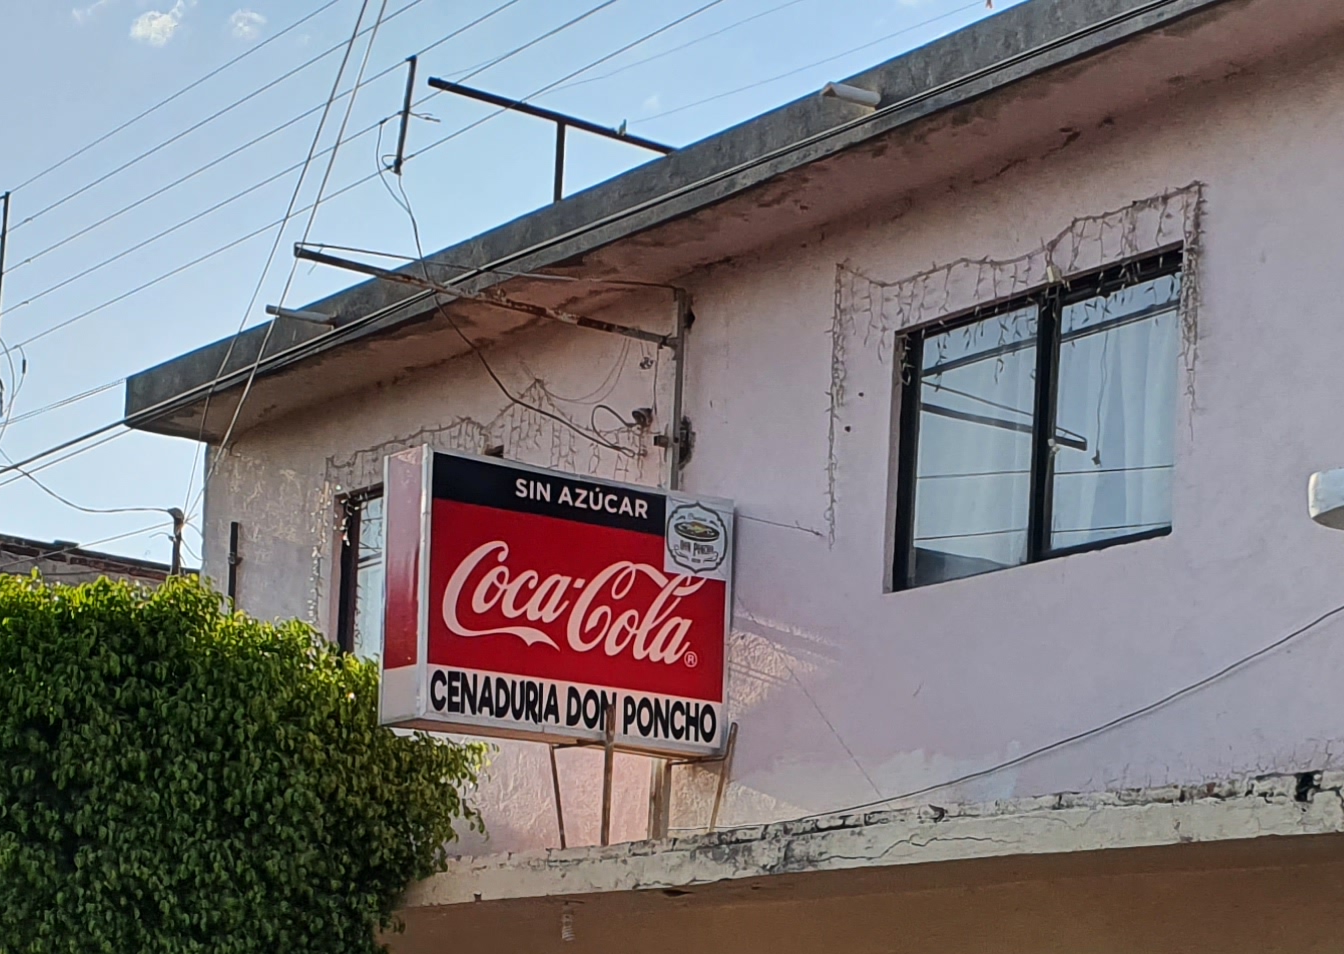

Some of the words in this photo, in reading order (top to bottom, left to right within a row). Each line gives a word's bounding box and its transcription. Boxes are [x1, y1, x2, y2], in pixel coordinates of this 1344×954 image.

[515, 477, 551, 503] SIN
[558, 485, 648, 520] AZÚCAR
[442, 540, 708, 665] Coca-Cola
[430, 669, 560, 725] CENADURIA
[566, 686, 618, 731] DON
[623, 696, 717, 743] PONCHO
